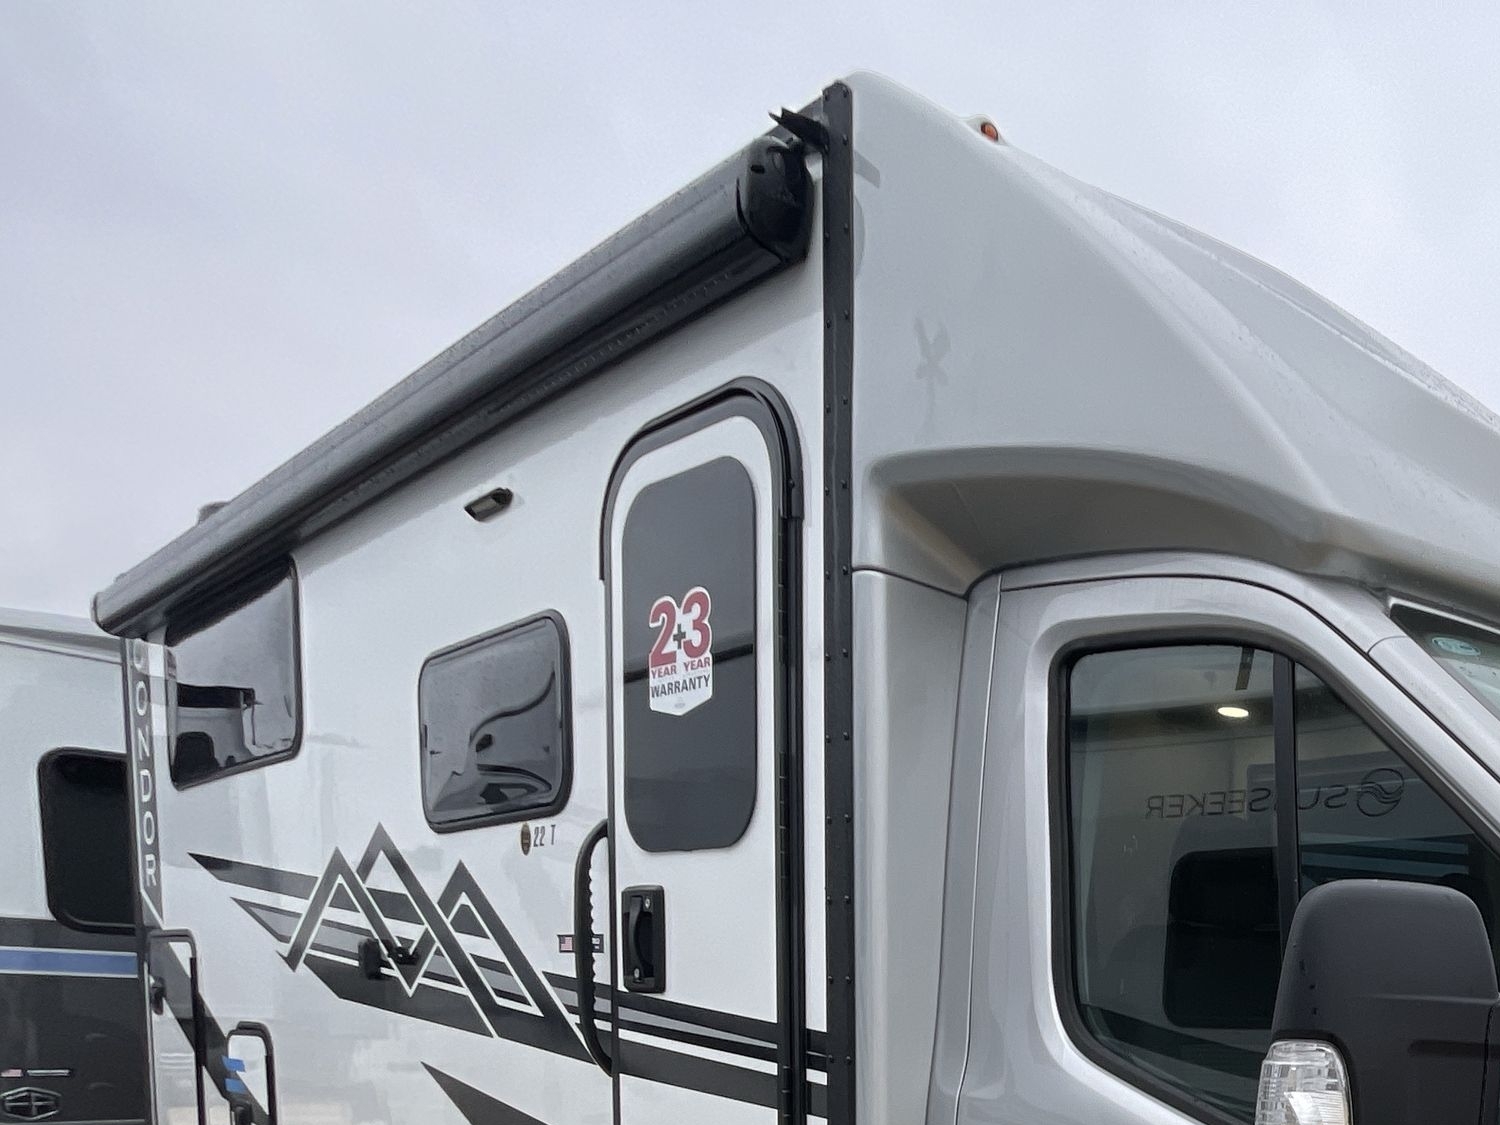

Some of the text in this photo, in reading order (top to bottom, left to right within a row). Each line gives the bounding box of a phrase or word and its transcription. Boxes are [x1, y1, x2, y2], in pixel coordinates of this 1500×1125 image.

[651, 657, 711, 679] YEAR YEAR
[650, 674, 711, 698] WARRANTY
[533, 824, 557, 847] 22 T
